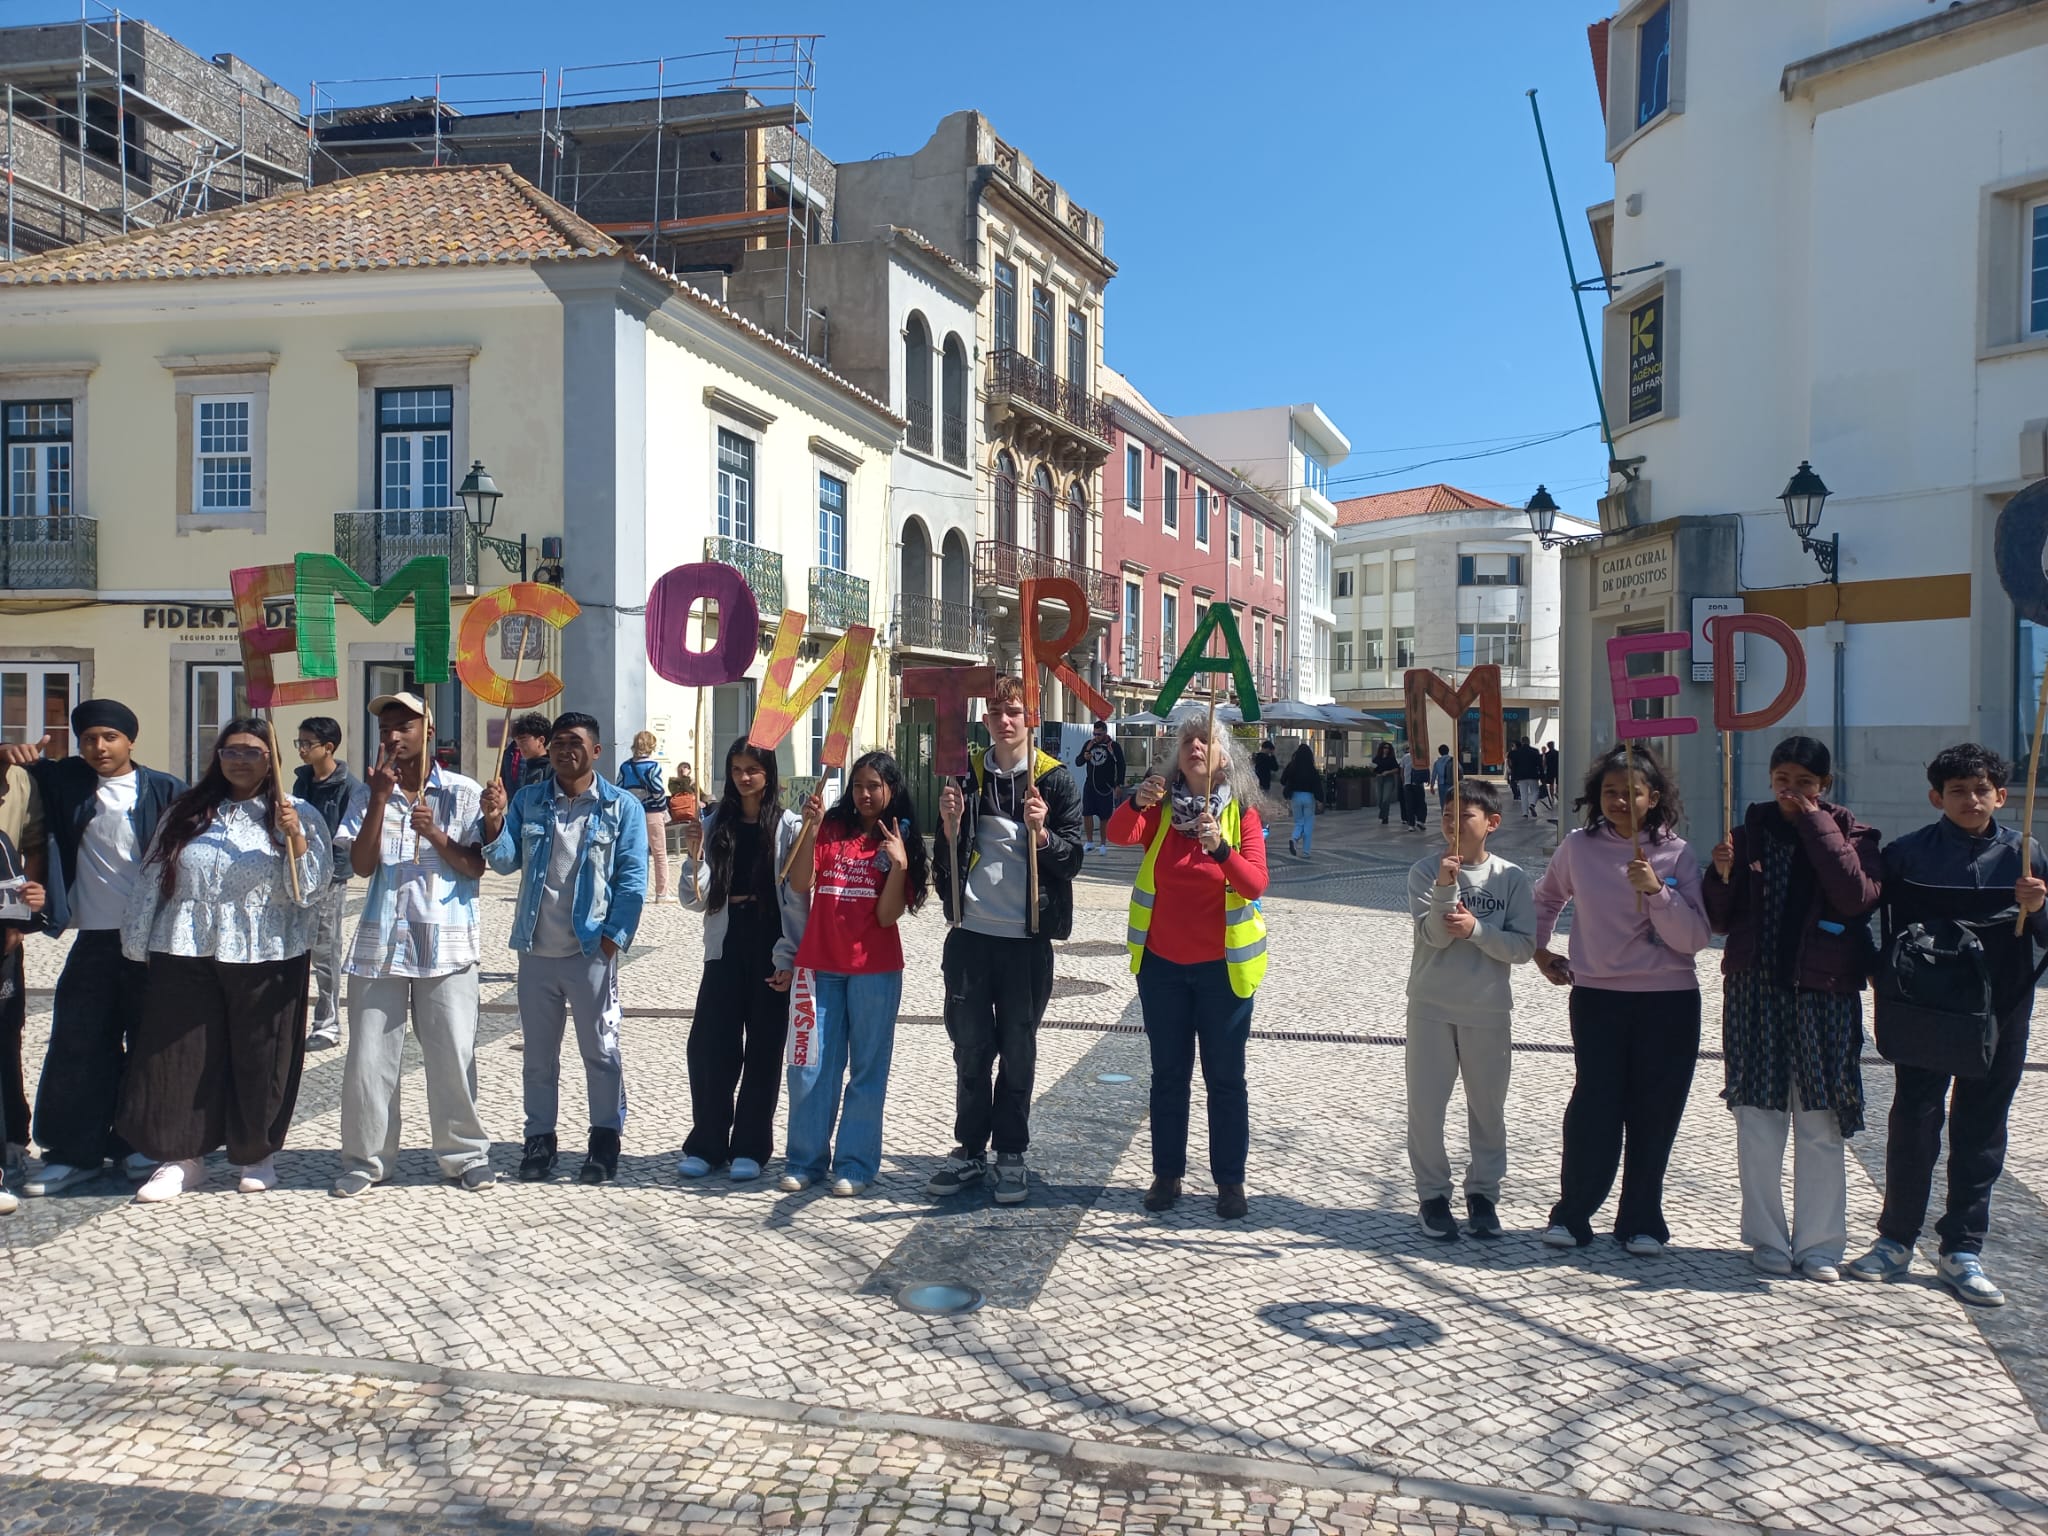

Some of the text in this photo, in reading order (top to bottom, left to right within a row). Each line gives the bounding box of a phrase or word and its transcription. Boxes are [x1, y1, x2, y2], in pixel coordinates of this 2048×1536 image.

[1632, 383, 1644, 397] EM
[1633, 362, 1662, 381] AGÊNCI
[1640, 351, 1655, 366] TUA
[1603, 548, 1667, 574] CAIXA GERAL
[1603, 568, 1667, 592] DE DEPOSITOS
[294, 552, 450, 683] M
[456, 582, 581, 709] C
[645, 562, 759, 687] O
[1019, 576, 1114, 728] R
[1153, 602, 1262, 722] A
[903, 666, 996, 776] T
[1404, 664, 1504, 770] M
[1606, 631, 1699, 739] E
[1712, 614, 1806, 731] D
[823, 870, 863, 883] GANHAMOS
[841, 856, 869, 867] CONTRA
[848, 866, 869, 875] FINAL
